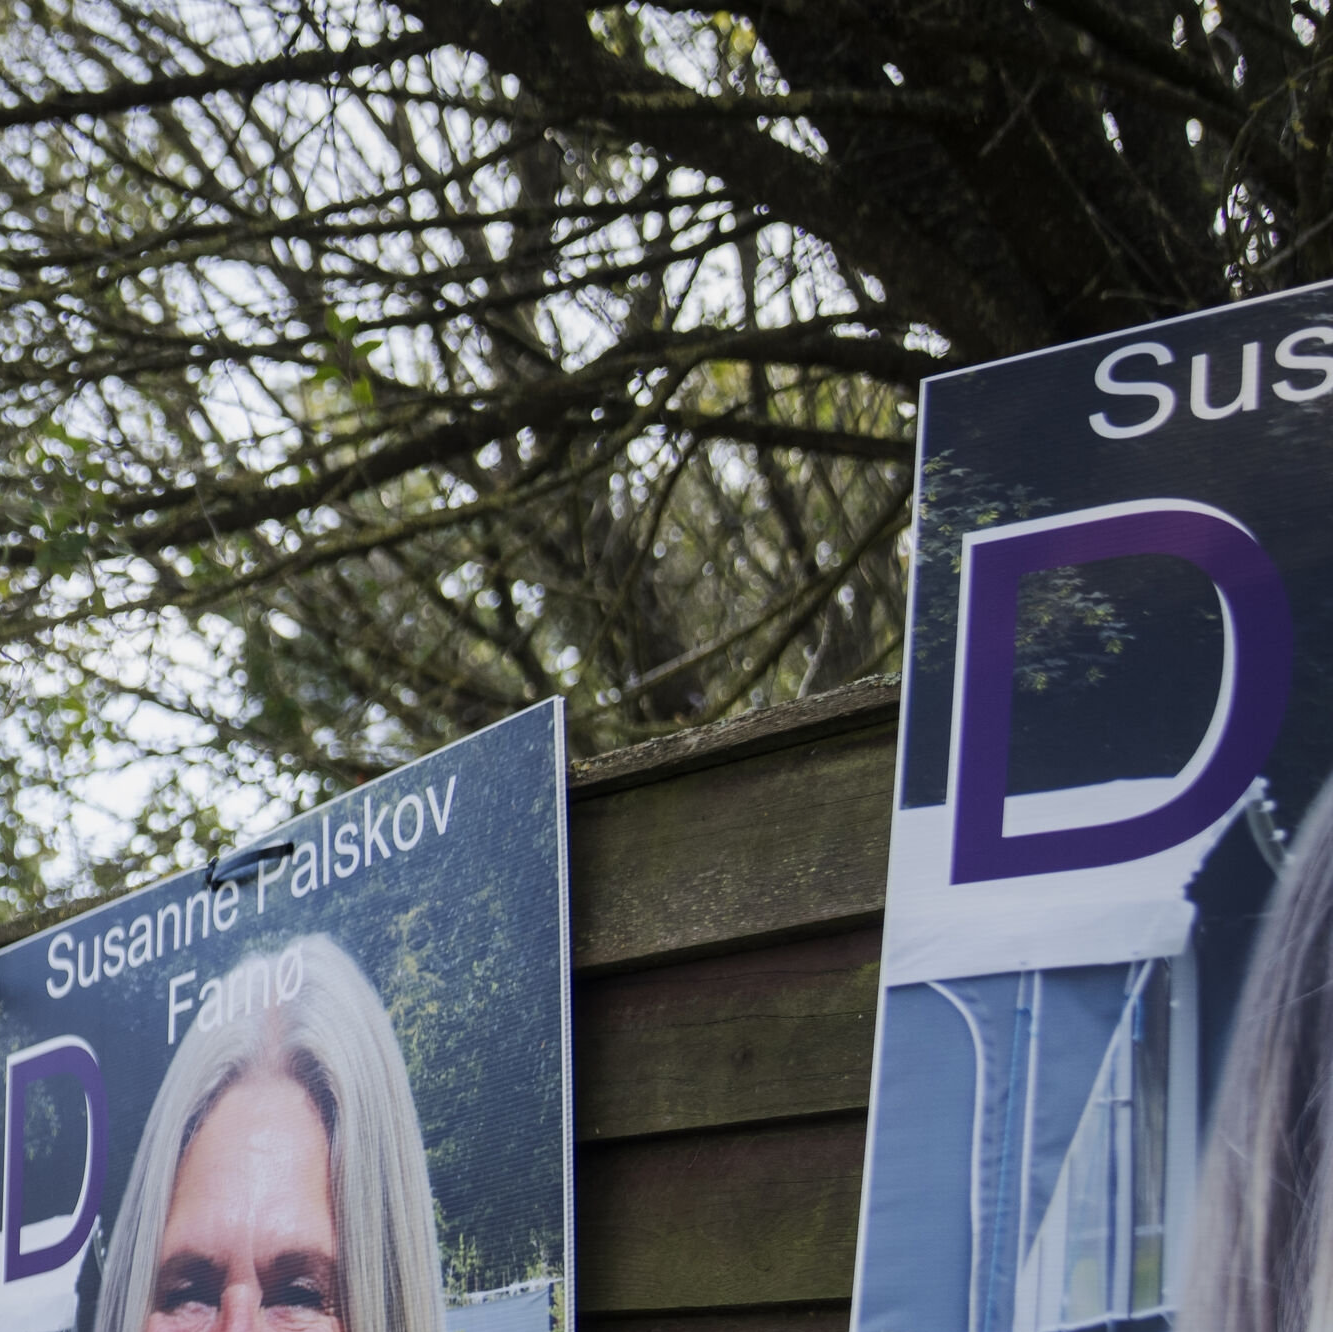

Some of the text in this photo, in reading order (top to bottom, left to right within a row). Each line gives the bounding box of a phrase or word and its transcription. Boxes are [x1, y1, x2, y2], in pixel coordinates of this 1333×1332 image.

[1089, 326, 1333, 440] Sus
[949, 498, 1296, 885] D
[45, 775, 457, 998] Susanne Palskov
[167, 943, 304, 1045] Farnø
[4, 1034, 108, 1285] D
